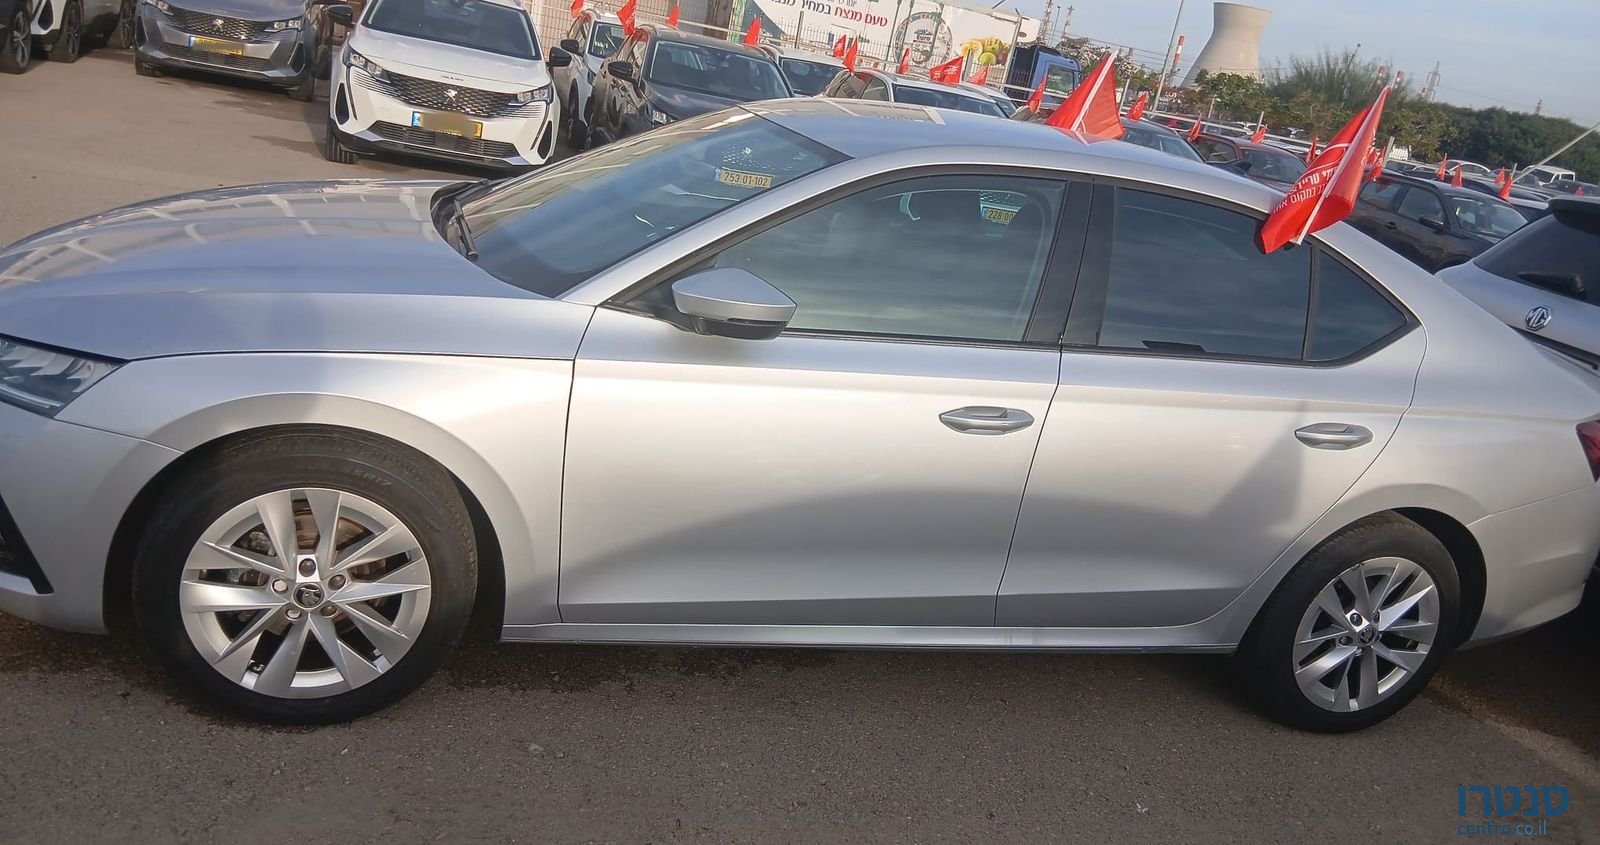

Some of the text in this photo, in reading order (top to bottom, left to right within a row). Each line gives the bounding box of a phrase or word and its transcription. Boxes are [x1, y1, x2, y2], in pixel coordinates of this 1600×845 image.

[834, 6, 862, 21] מנצח
[864, 13, 888, 26] טעם
[1526, 307, 1549, 328] MG
